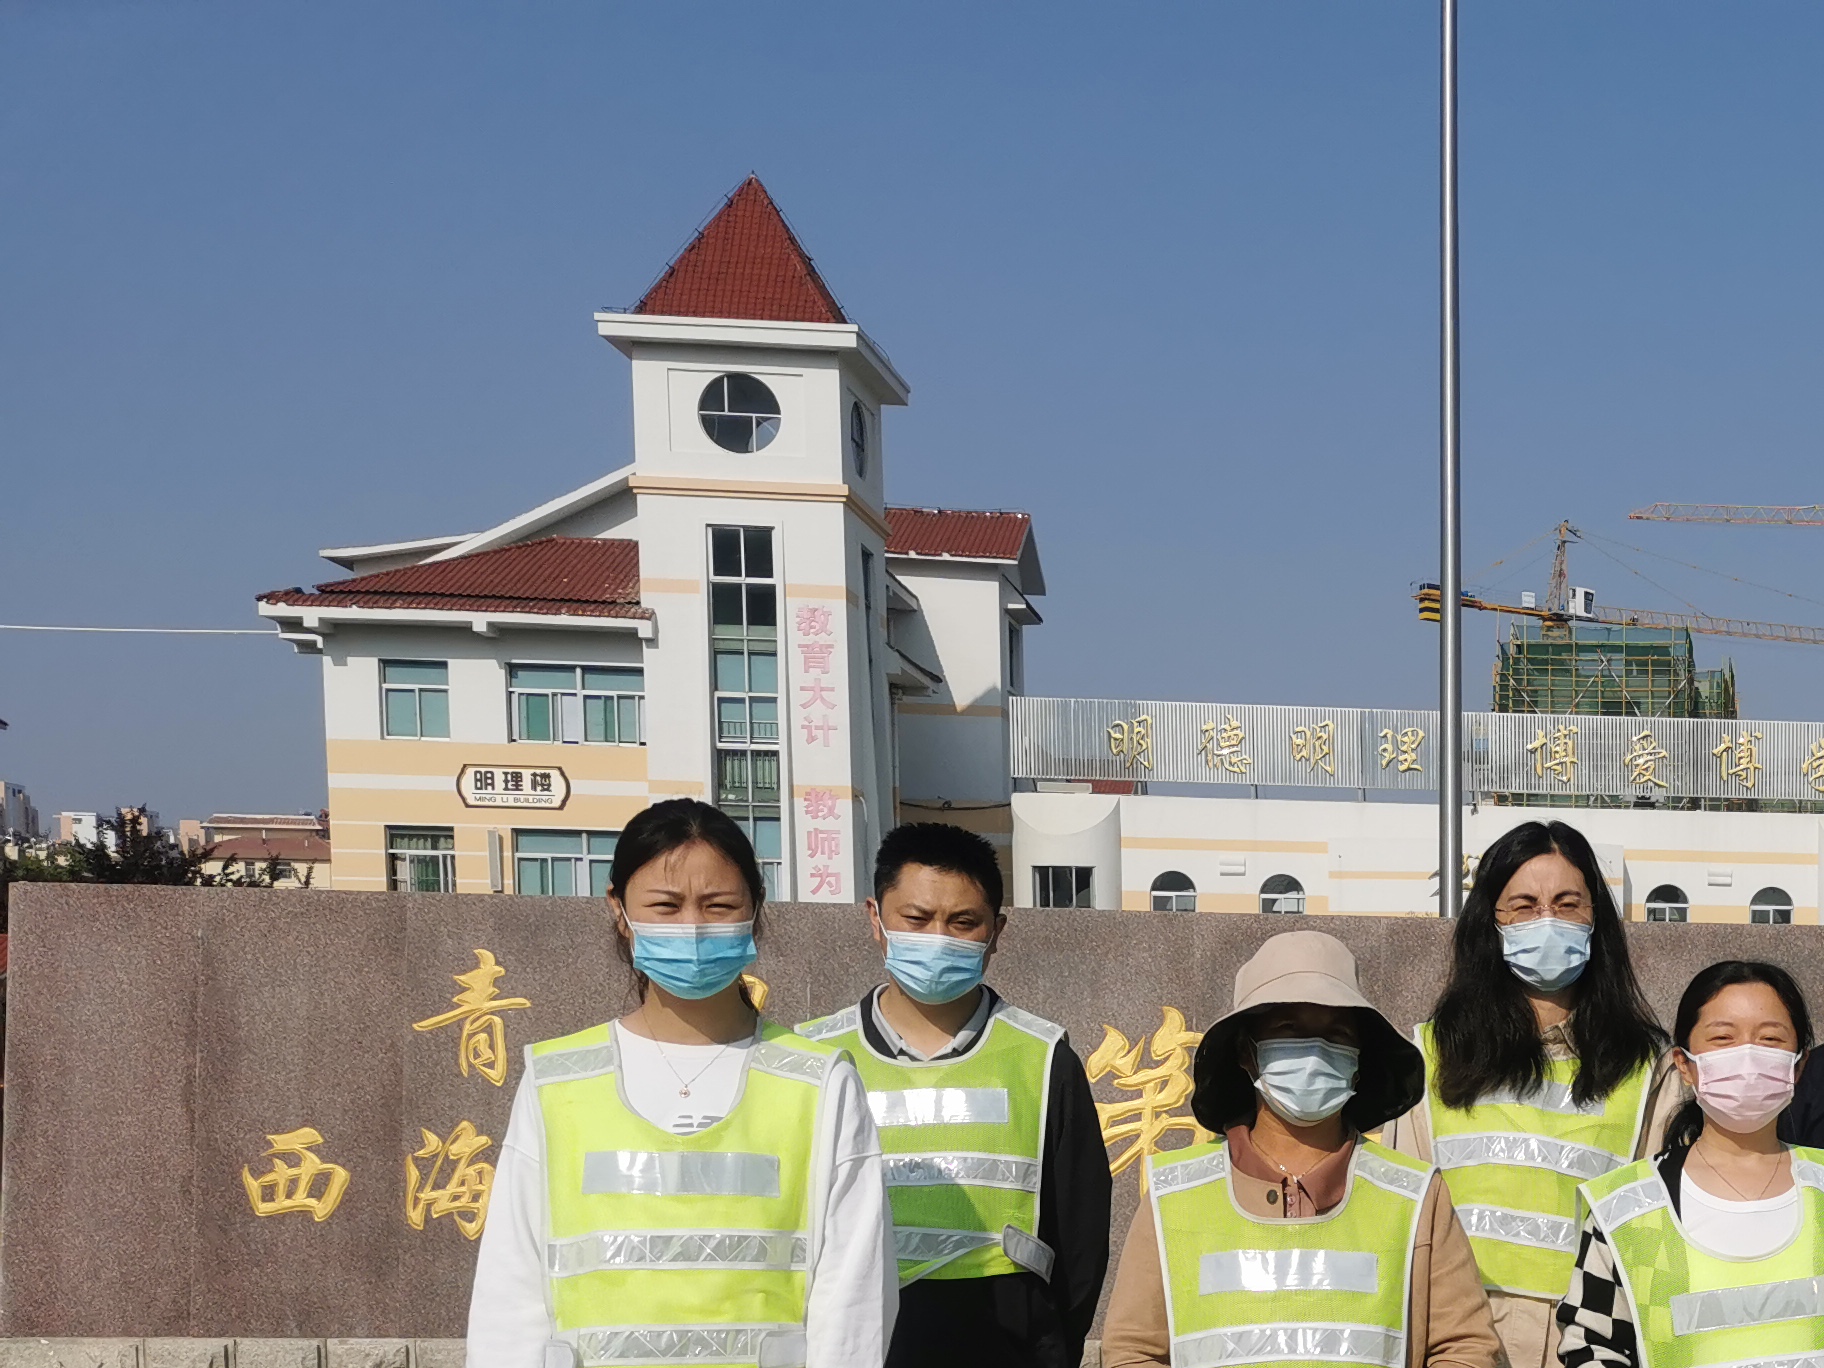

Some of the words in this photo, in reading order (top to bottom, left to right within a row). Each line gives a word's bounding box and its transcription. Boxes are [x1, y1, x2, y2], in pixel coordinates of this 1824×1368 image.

[795, 604, 838, 748] 教育大计
[473, 770, 553, 793] 明理楼
[1106, 714, 1426, 776] 明德明理
[513, 797, 553, 805] BUILDING
[803, 787, 842, 896] 教师为
[242, 1120, 498, 1241] 西海
